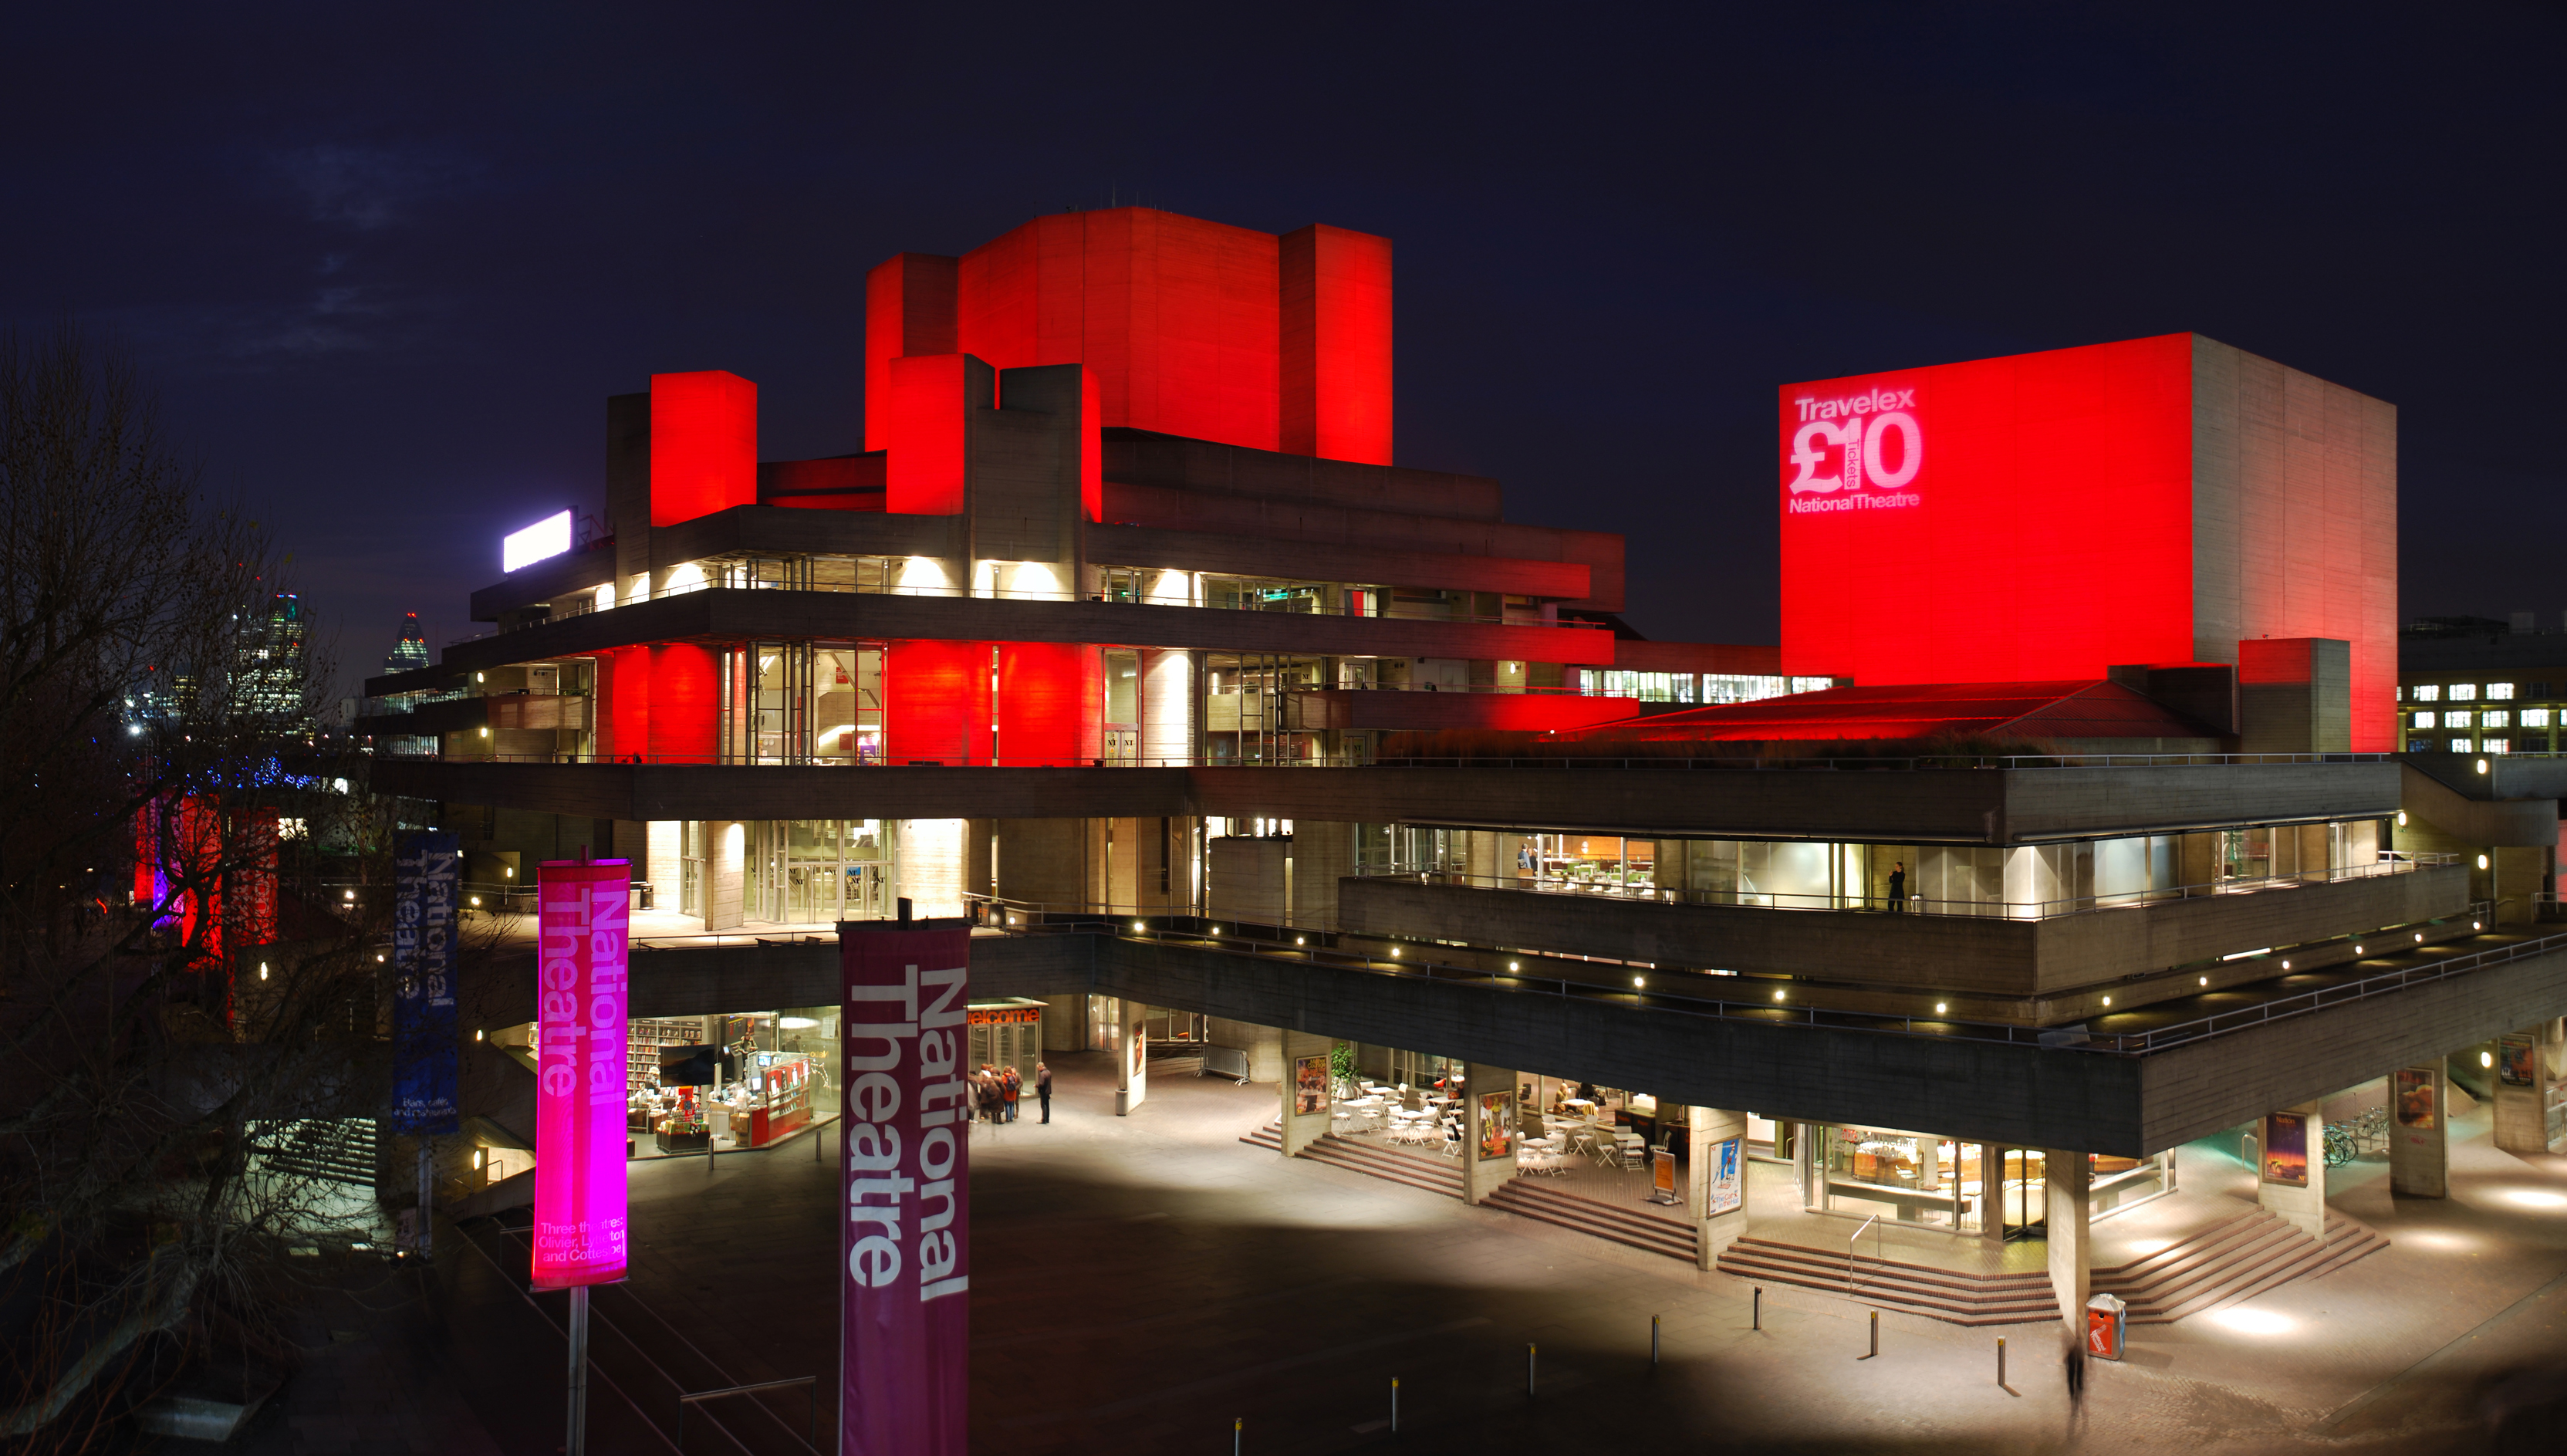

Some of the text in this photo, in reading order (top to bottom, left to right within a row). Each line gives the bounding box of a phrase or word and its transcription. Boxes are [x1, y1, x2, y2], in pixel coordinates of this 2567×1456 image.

[1795, 389, 1915, 422] Travelex
[1789, 412, 1922, 495] £10
[1846, 438, 1859, 488] Tickets
[396, 850, 427, 999] Theatre
[427, 853, 455, 1006] National
[543, 888, 589, 1097] Theatre
[589, 890, 628, 1106] National
[394, 1108, 410, 1116] and
[403, 1097, 426, 1107] Bars,
[849, 964, 918, 1287] Theatre
[2276, 1116, 2295, 1124] Nation
[919, 967, 968, 1302] National
[1832, 1127, 1917, 1149] National Theatre
[1832, 1139, 1901, 1158] Espresso Bar
[541, 1217, 623, 1234] Three theatres:
[539, 1229, 624, 1248] Olivier, Lyttelton
[543, 1244, 622, 1262] and Cottesloe
[2090, 1333, 2102, 1352] Theatre
[2092, 1329, 2106, 1351] National
